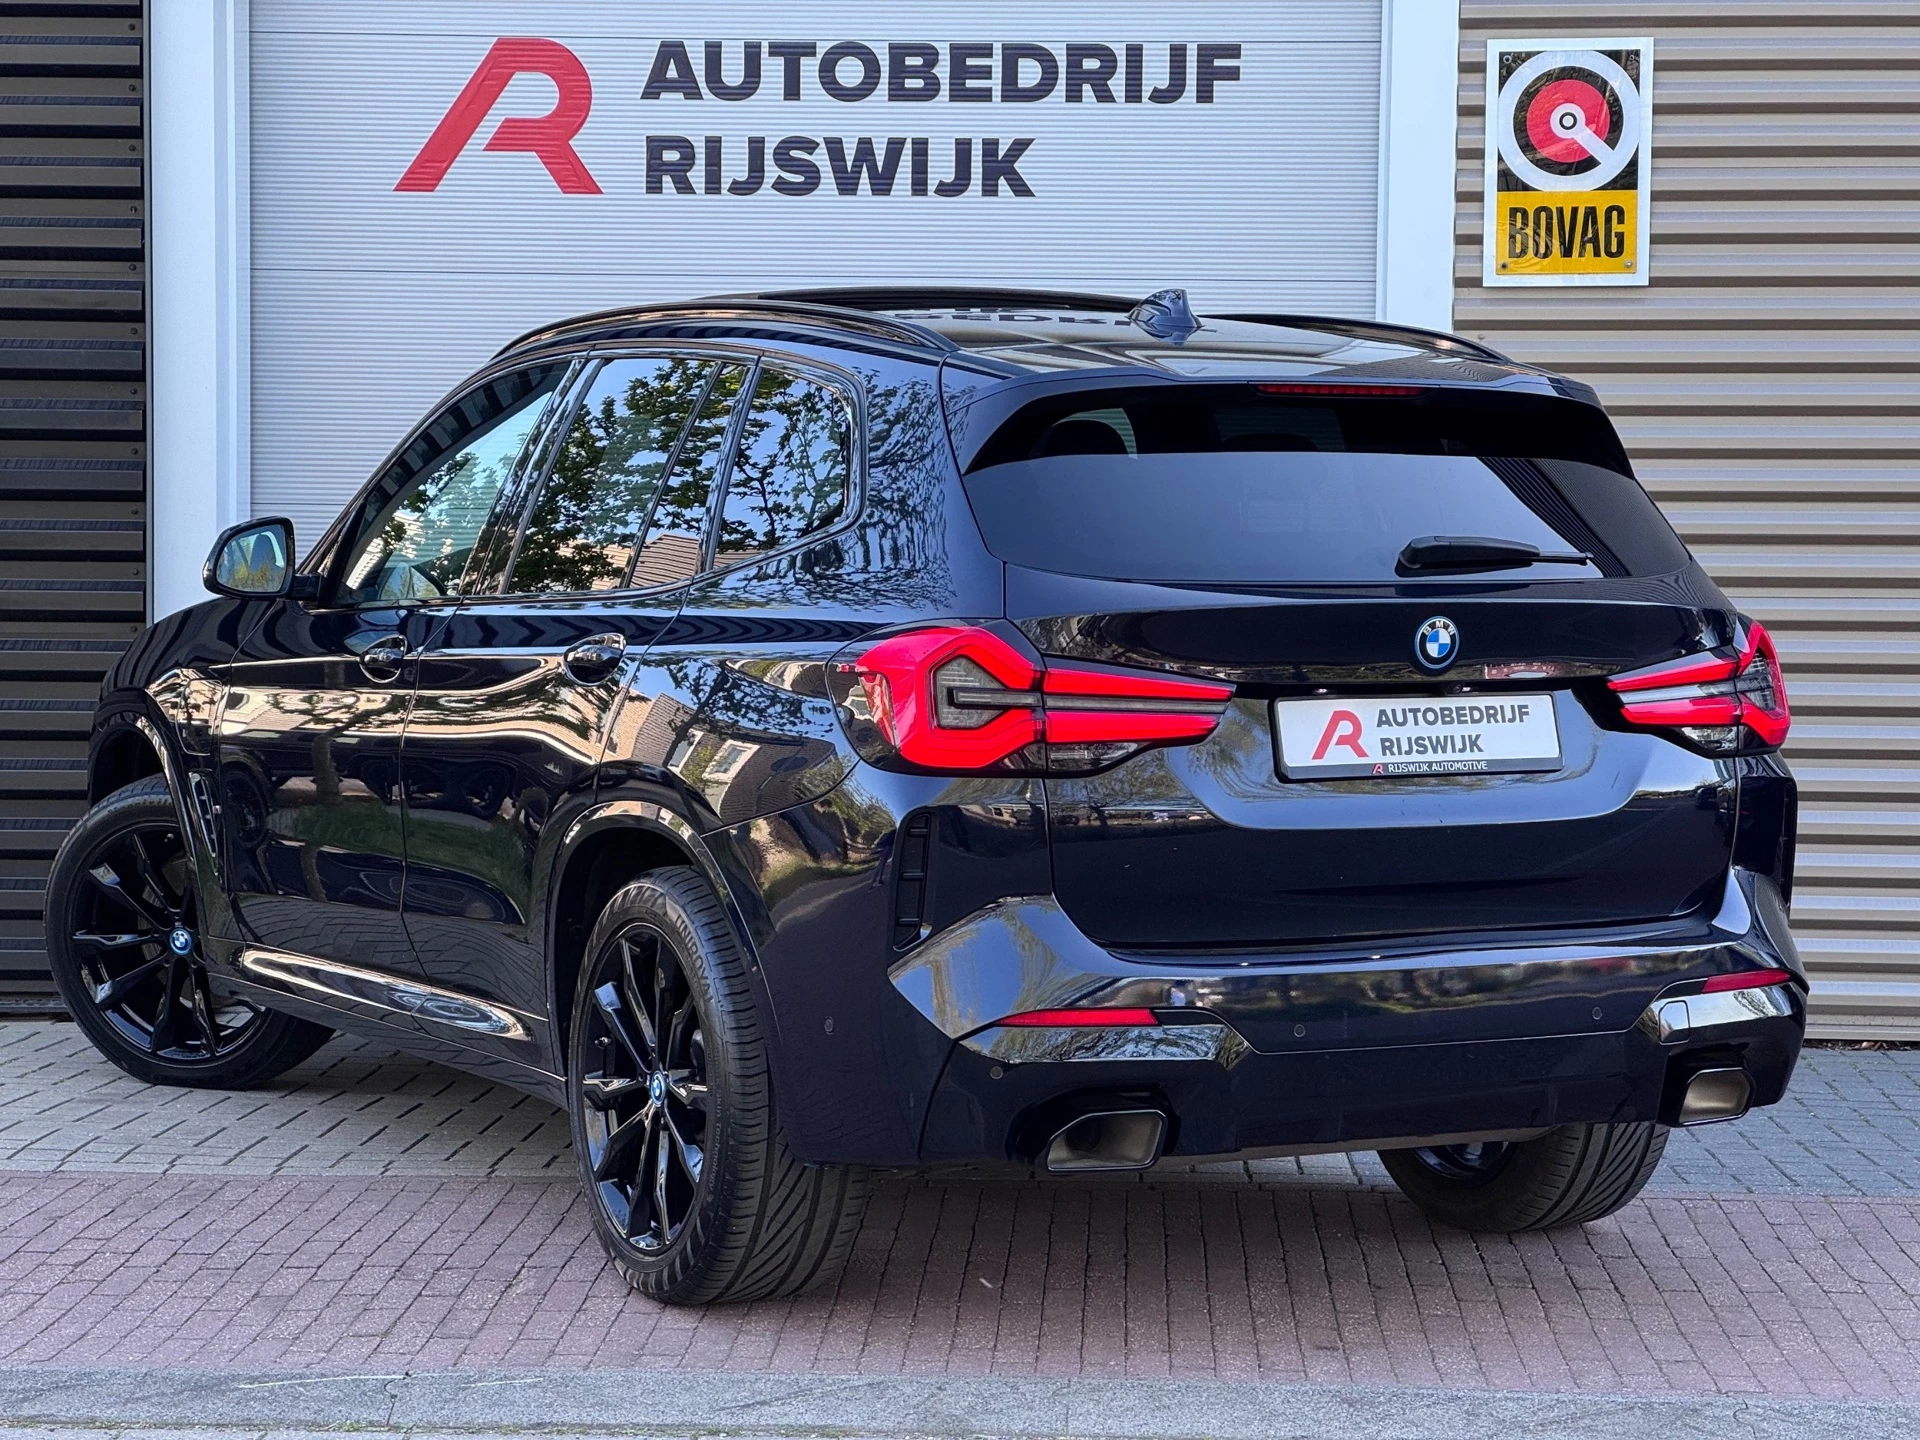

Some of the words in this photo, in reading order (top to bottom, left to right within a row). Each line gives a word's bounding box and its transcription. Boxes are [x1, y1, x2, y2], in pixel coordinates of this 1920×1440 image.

[641, 41, 1242, 104] AUTOBEDRIJF
[645, 136, 1036, 198] RIJSWIJK
[1508, 204, 1626, 259] BOVAG
[1423, 620, 1455, 636] BMW
[1376, 705, 1530, 728] AUTOBEDRIJF
[1380, 734, 1484, 757] RIJSWIJK
[1388, 763, 1430, 773] RIJSWIJK
[1431, 761, 1488, 772] AUTOMOTIVE
[675, 913, 714, 1002] UNIROYAL
